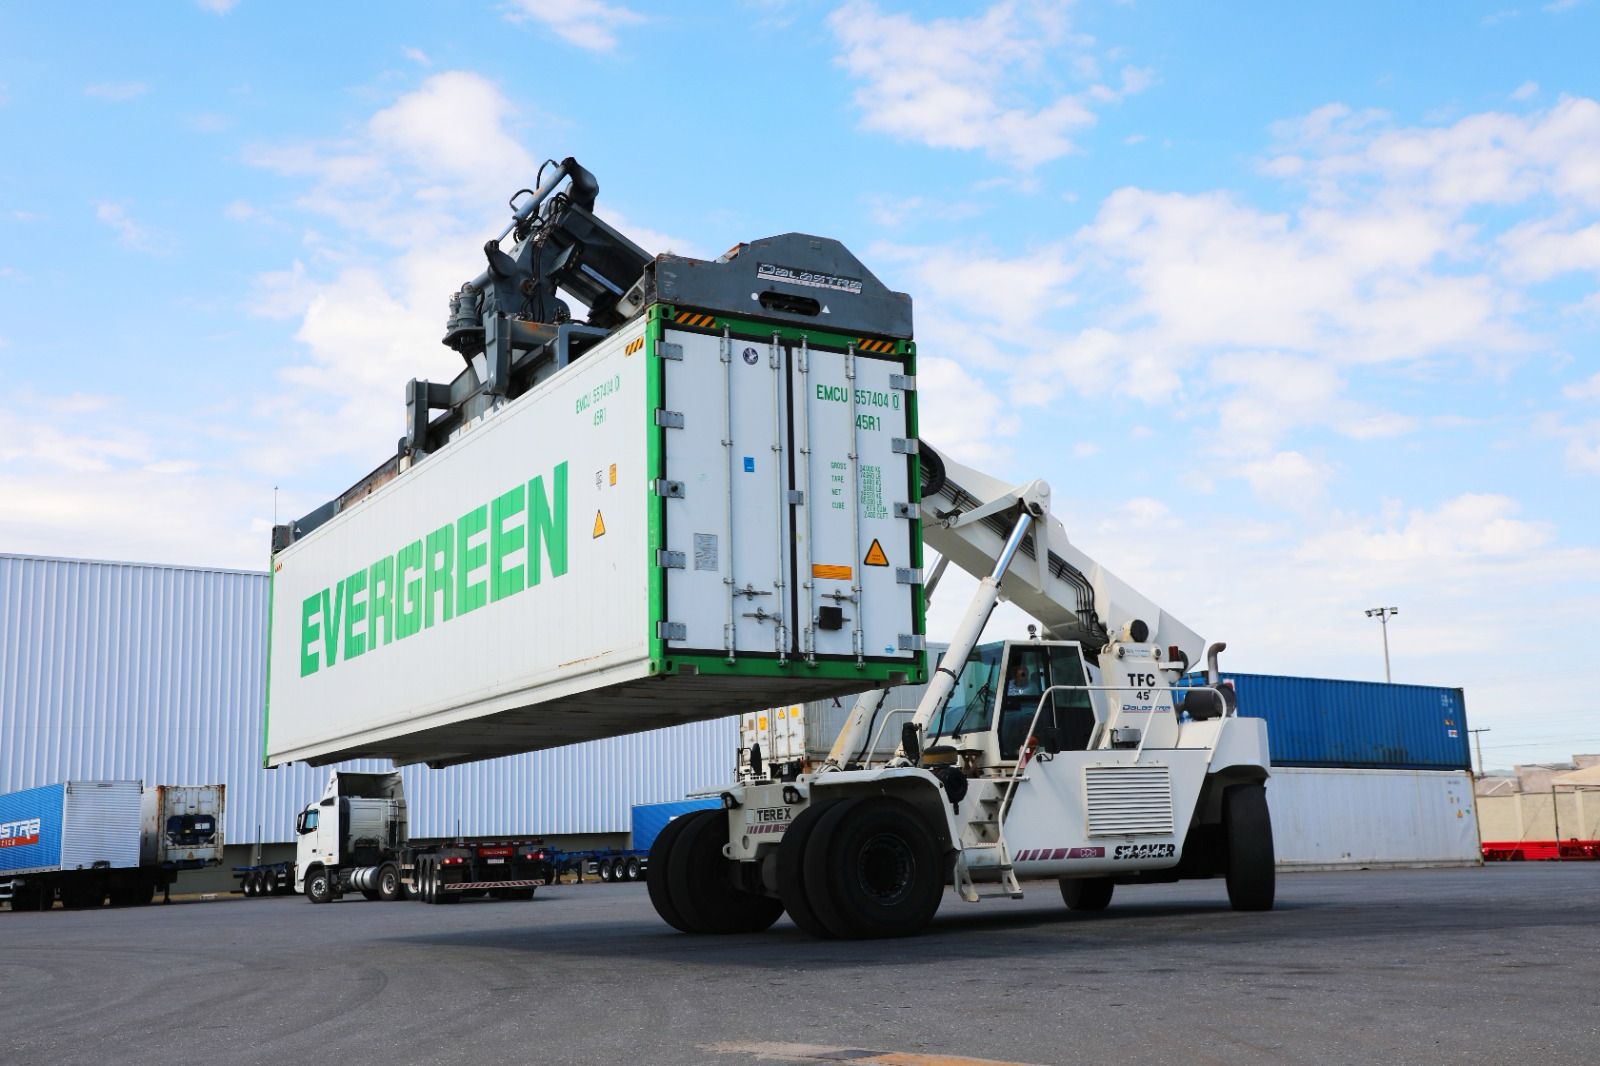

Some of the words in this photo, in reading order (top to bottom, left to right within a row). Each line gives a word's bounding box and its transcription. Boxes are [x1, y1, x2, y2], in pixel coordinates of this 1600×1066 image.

[816, 384, 848, 403] EMCU
[855, 390, 889, 408] 557404
[856, 414, 880, 431] 45R1
[832, 488, 841, 496] NET
[300, 460, 568, 678] EVERGREEN
[1127, 673, 1156, 687] TFC
[757, 807, 792, 821] TEREX
[1113, 843, 1176, 860] STACKER
